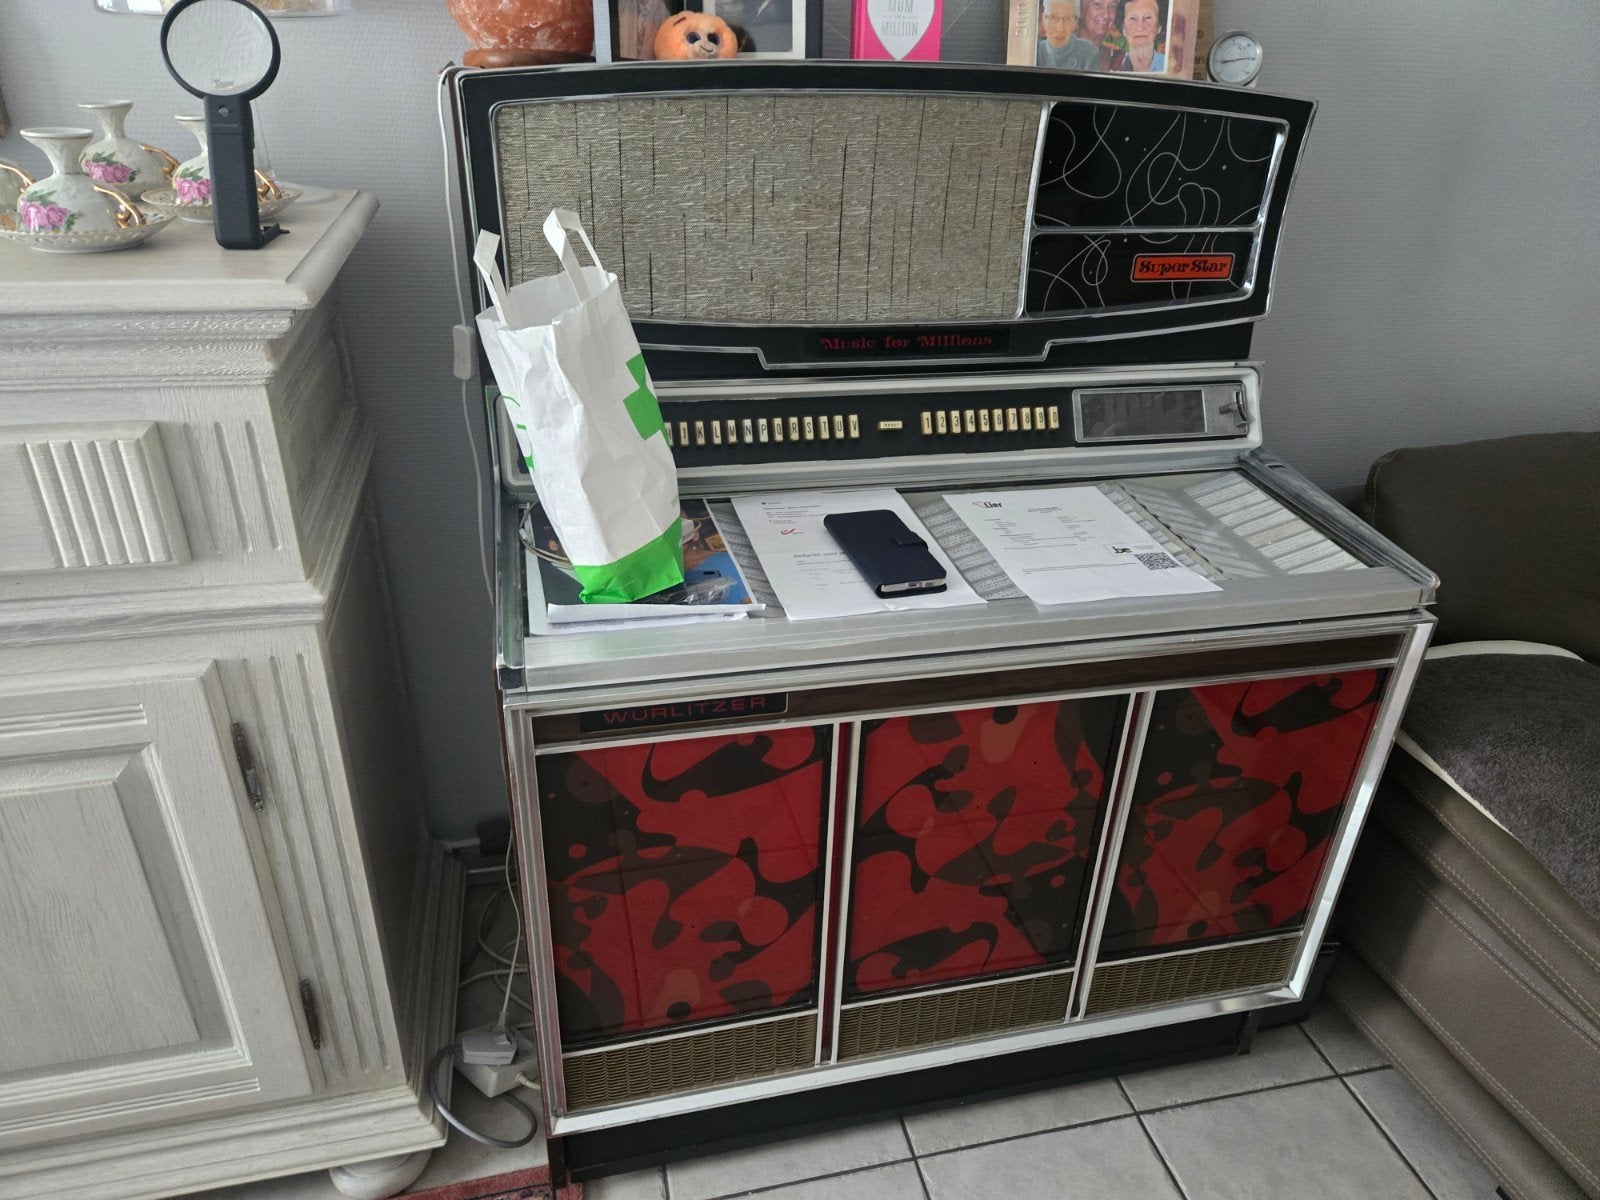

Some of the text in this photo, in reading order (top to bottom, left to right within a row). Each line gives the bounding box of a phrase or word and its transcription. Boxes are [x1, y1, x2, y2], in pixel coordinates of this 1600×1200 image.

[881, 21, 919, 37] MILLION
[1139, 259, 1228, 276] Super Star
[819, 333, 993, 350] Music for Millions
[603, 696, 766, 724] WURLITZER
